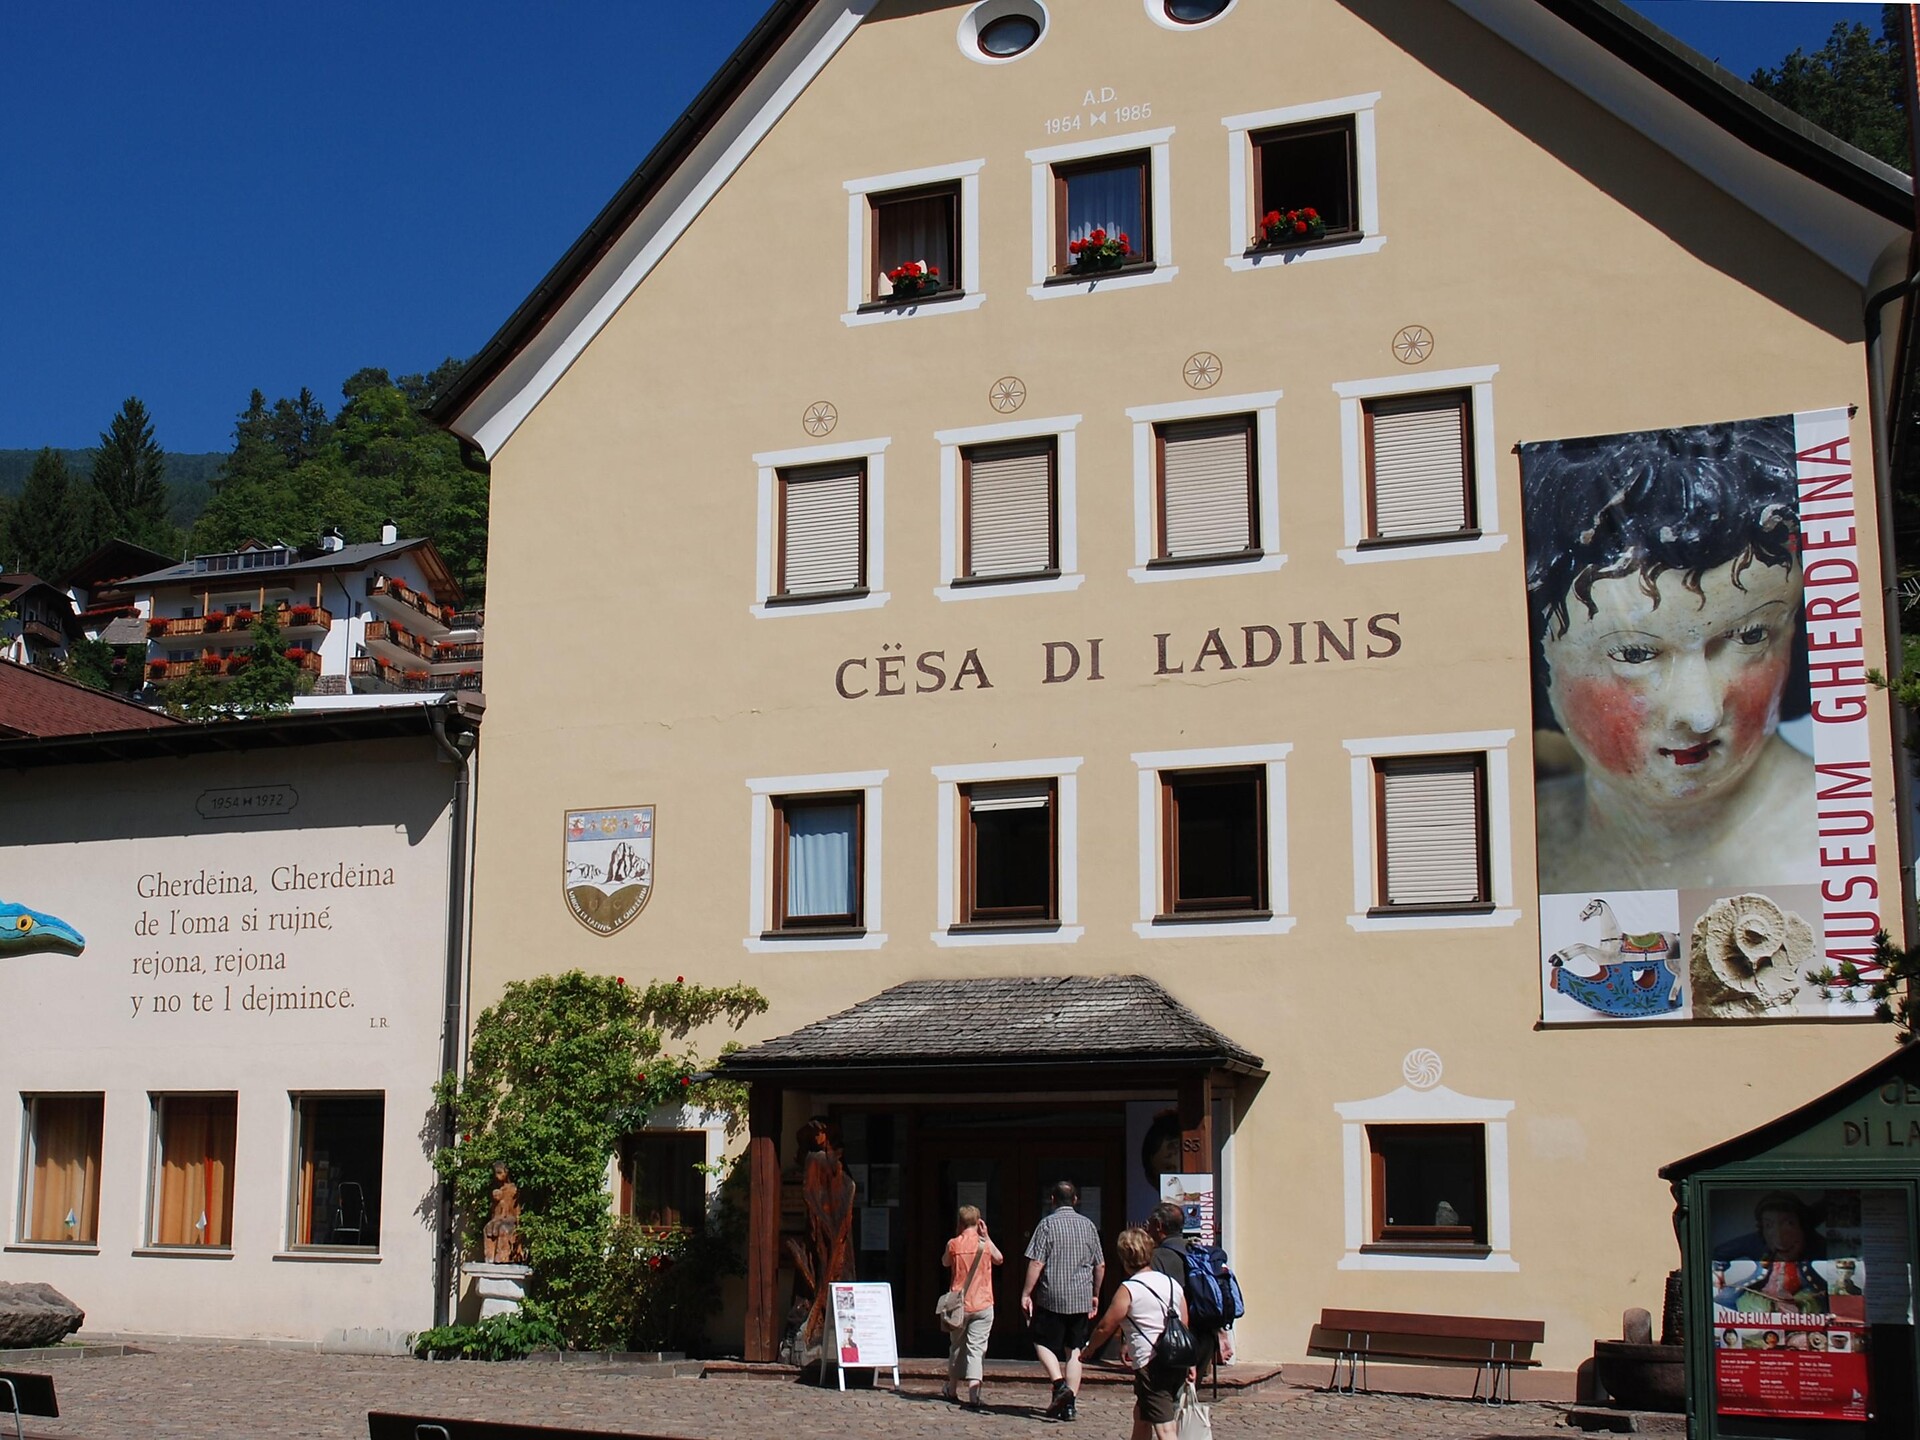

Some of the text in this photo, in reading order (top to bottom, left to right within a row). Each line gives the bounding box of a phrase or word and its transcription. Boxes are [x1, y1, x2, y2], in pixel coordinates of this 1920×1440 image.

[1083, 87, 1118, 106] A.D.
[1045, 103, 1152, 134] 1954 1985
[835, 612, 1402, 699] CËSA DI LADINS
[1793, 436, 1884, 986] MUSEUM GHERDEINA
[211, 793, 284, 809] 1954 1972
[137, 862, 395, 899] Gherdëina, Gherdëina
[134, 910, 159, 937] de
[241, 908, 259, 932] si
[268, 906, 333, 936] rujné,
[131, 948, 287, 980] rejona, rejona
[131, 995, 144, 1019] y
[153, 994, 181, 1013] no
[193, 992, 214, 1012] te
[1718, 1310, 1772, 1325] MUSEUM
